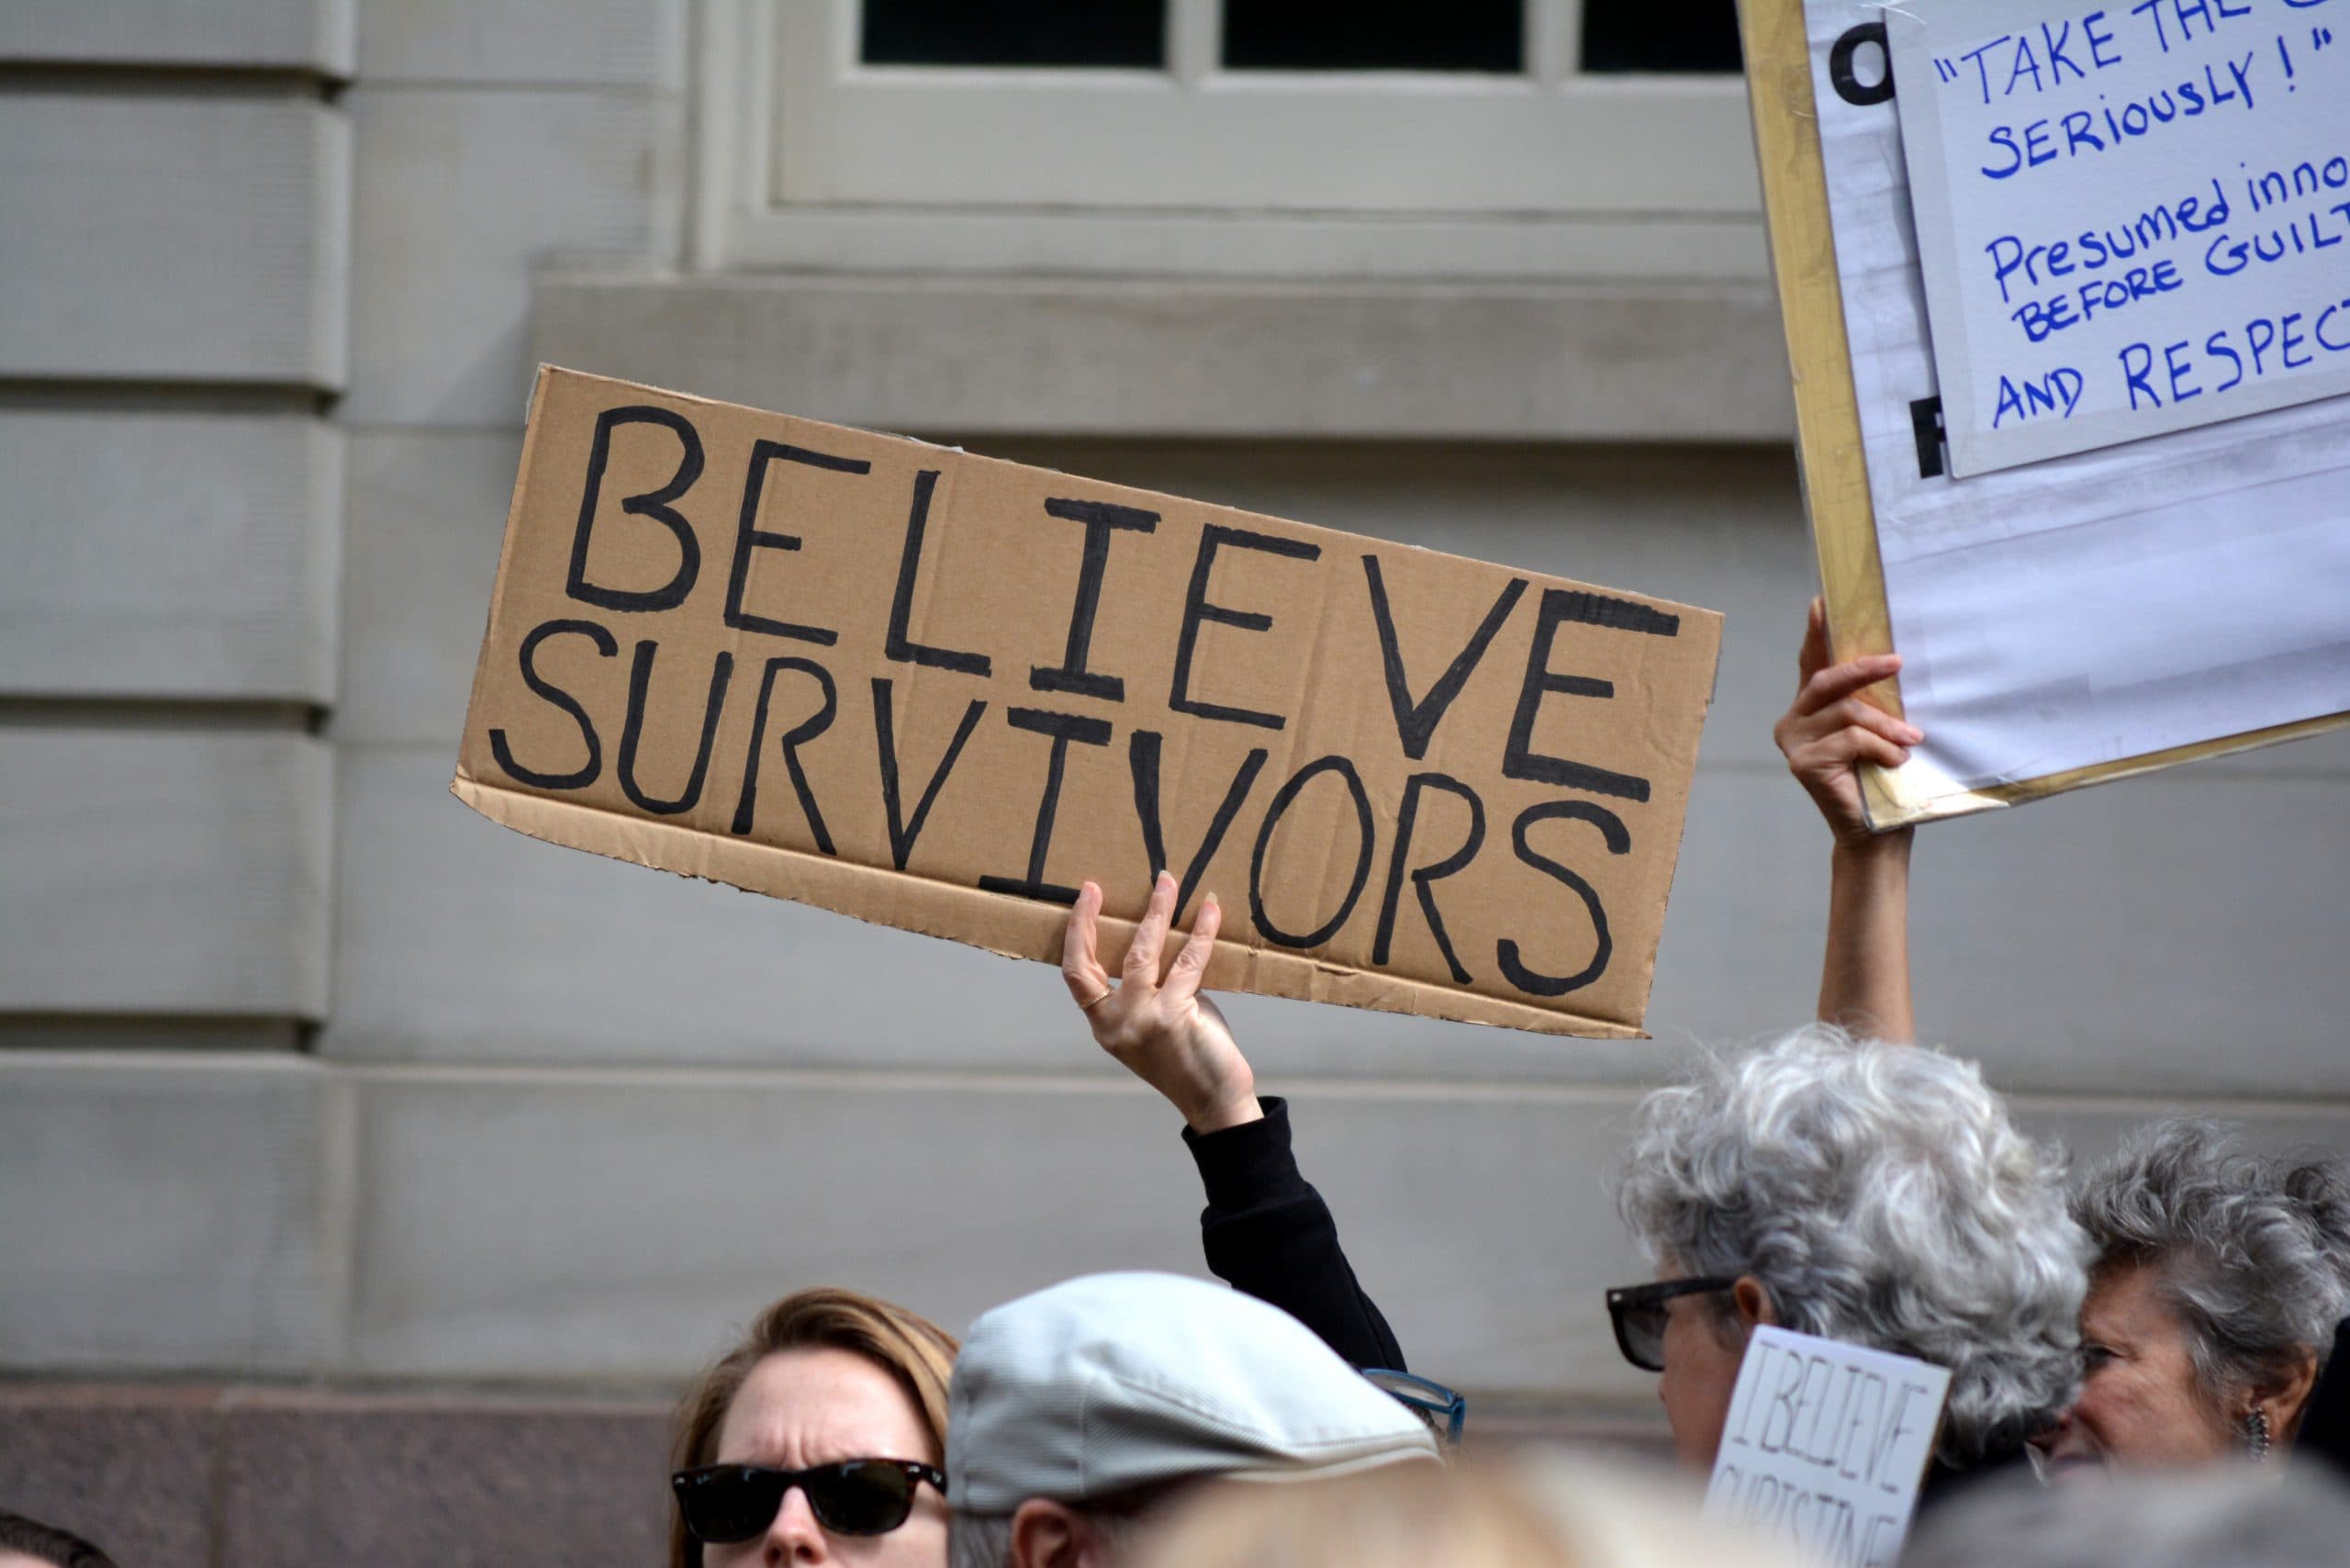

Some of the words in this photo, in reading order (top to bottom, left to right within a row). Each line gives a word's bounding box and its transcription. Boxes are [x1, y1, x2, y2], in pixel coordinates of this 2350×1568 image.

[1933, 11, 2122, 105] "TAKE
[1985, 178, 2230, 304] Presumed
[2240, 156, 2348, 213] inno
[1993, 367, 2083, 430] AND
[2119, 298, 2350, 411] RESPEC
[2011, 259, 2183, 342] BEFORE
[565, 406, 1680, 802] BELIEVE
[488, 619, 1630, 998] SURVIVORS
